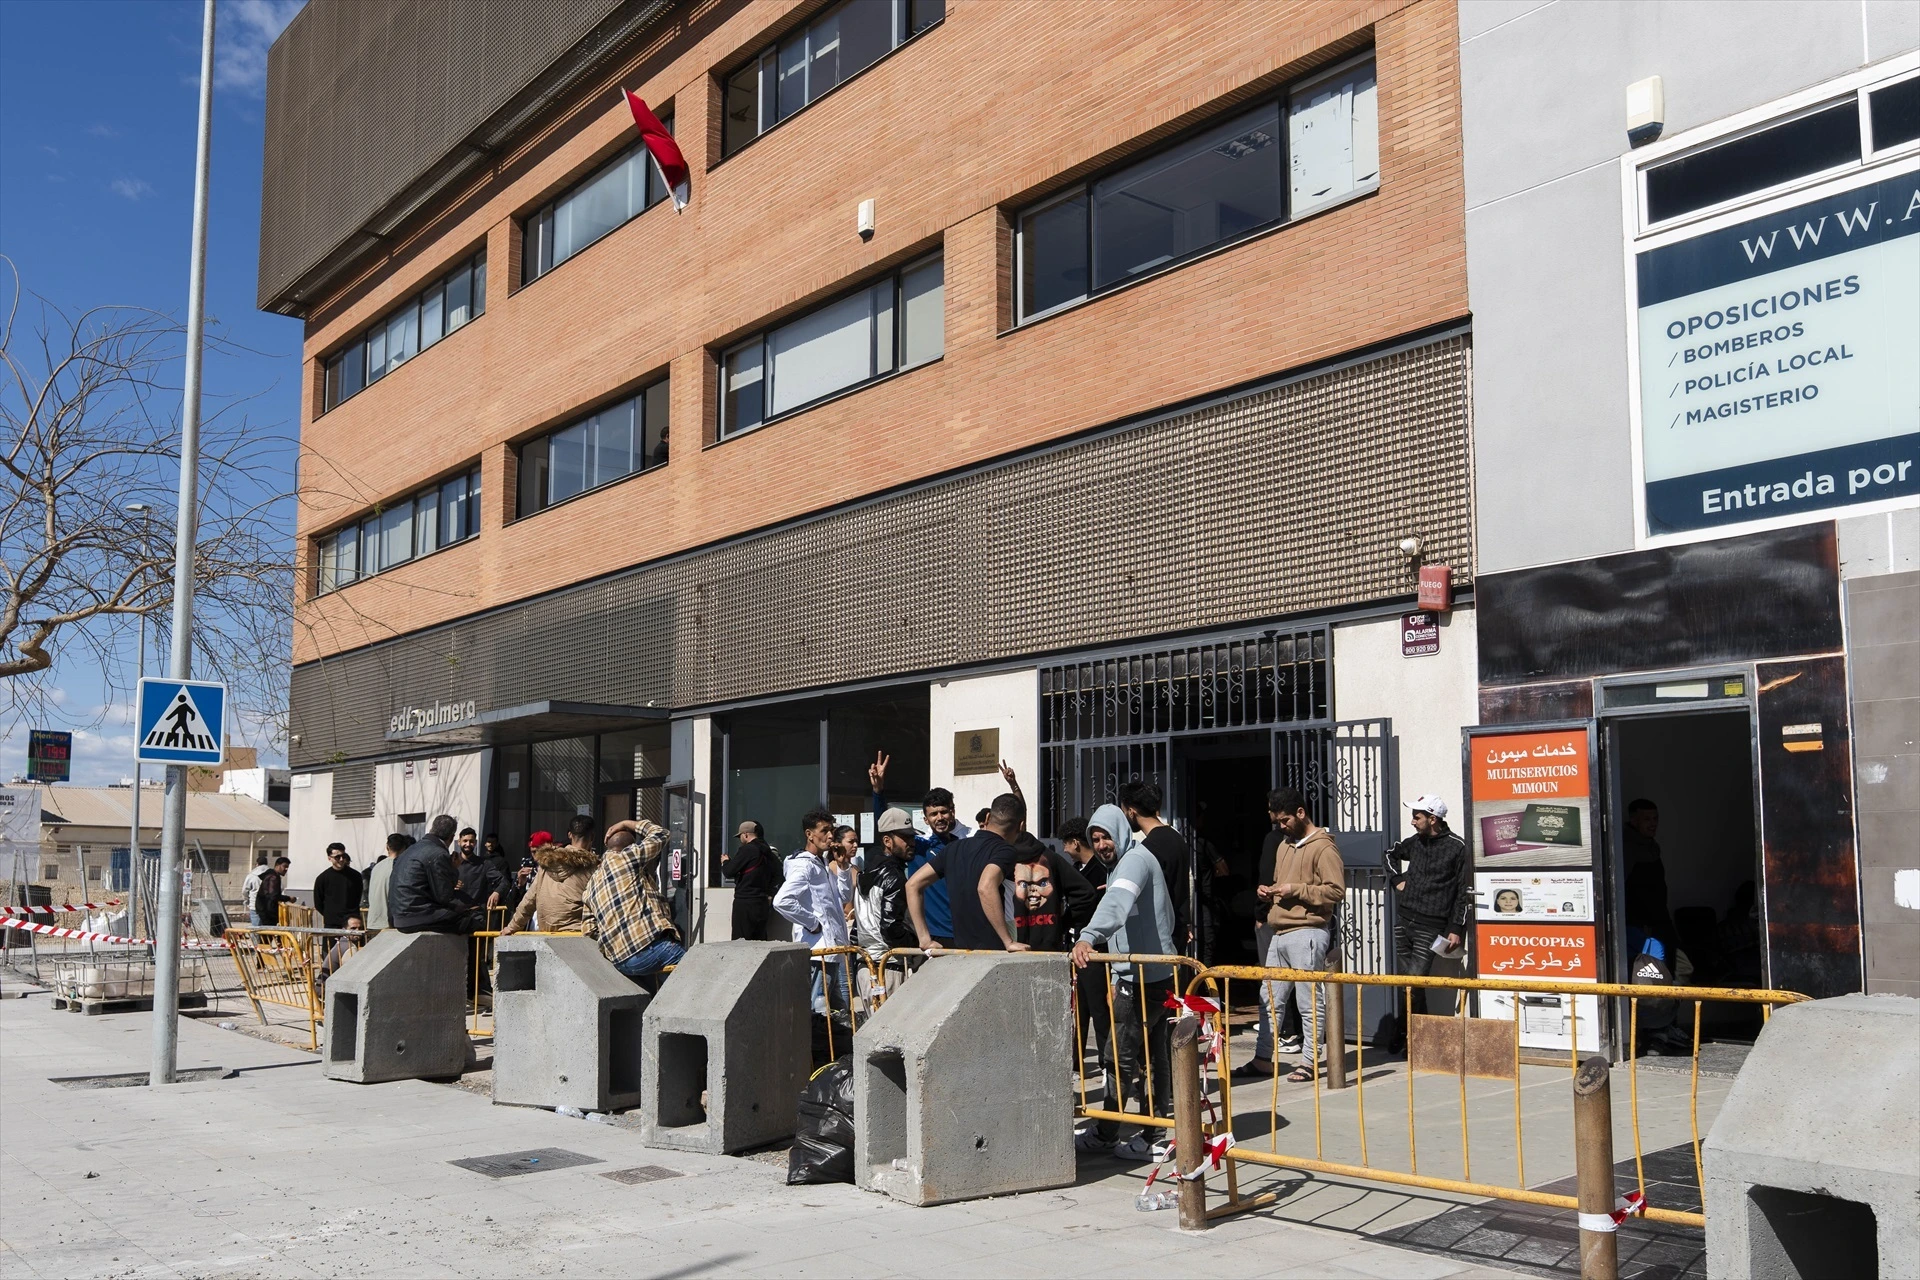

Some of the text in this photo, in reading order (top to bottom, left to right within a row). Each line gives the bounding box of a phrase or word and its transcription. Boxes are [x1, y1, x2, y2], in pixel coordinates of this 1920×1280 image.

[1666, 275, 1861, 340] OPOSICIONES
[1684, 322, 1805, 363] BOMBEROS
[1685, 344, 1854, 394] POLICÍA LOCAL
[1686, 384, 1819, 426] MAGISTERIO
[1702, 459, 1912, 514] Entrada por
[1420, 581, 1442, 589] FUEGO
[1415, 628, 1437, 636] ALARMA
[390, 700, 476, 736] edf. palmera
[1486, 742, 1577, 763] خدمات ميمون
[1487, 765, 1578, 780] MULTISERVICIOS
[1512, 782, 1558, 794] MIMOUN
[1490, 935, 1585, 948] FOTOCOPIAS
[1492, 952, 1582, 971] فوطوكوبي
[1636, 971, 1664, 980] adidas
